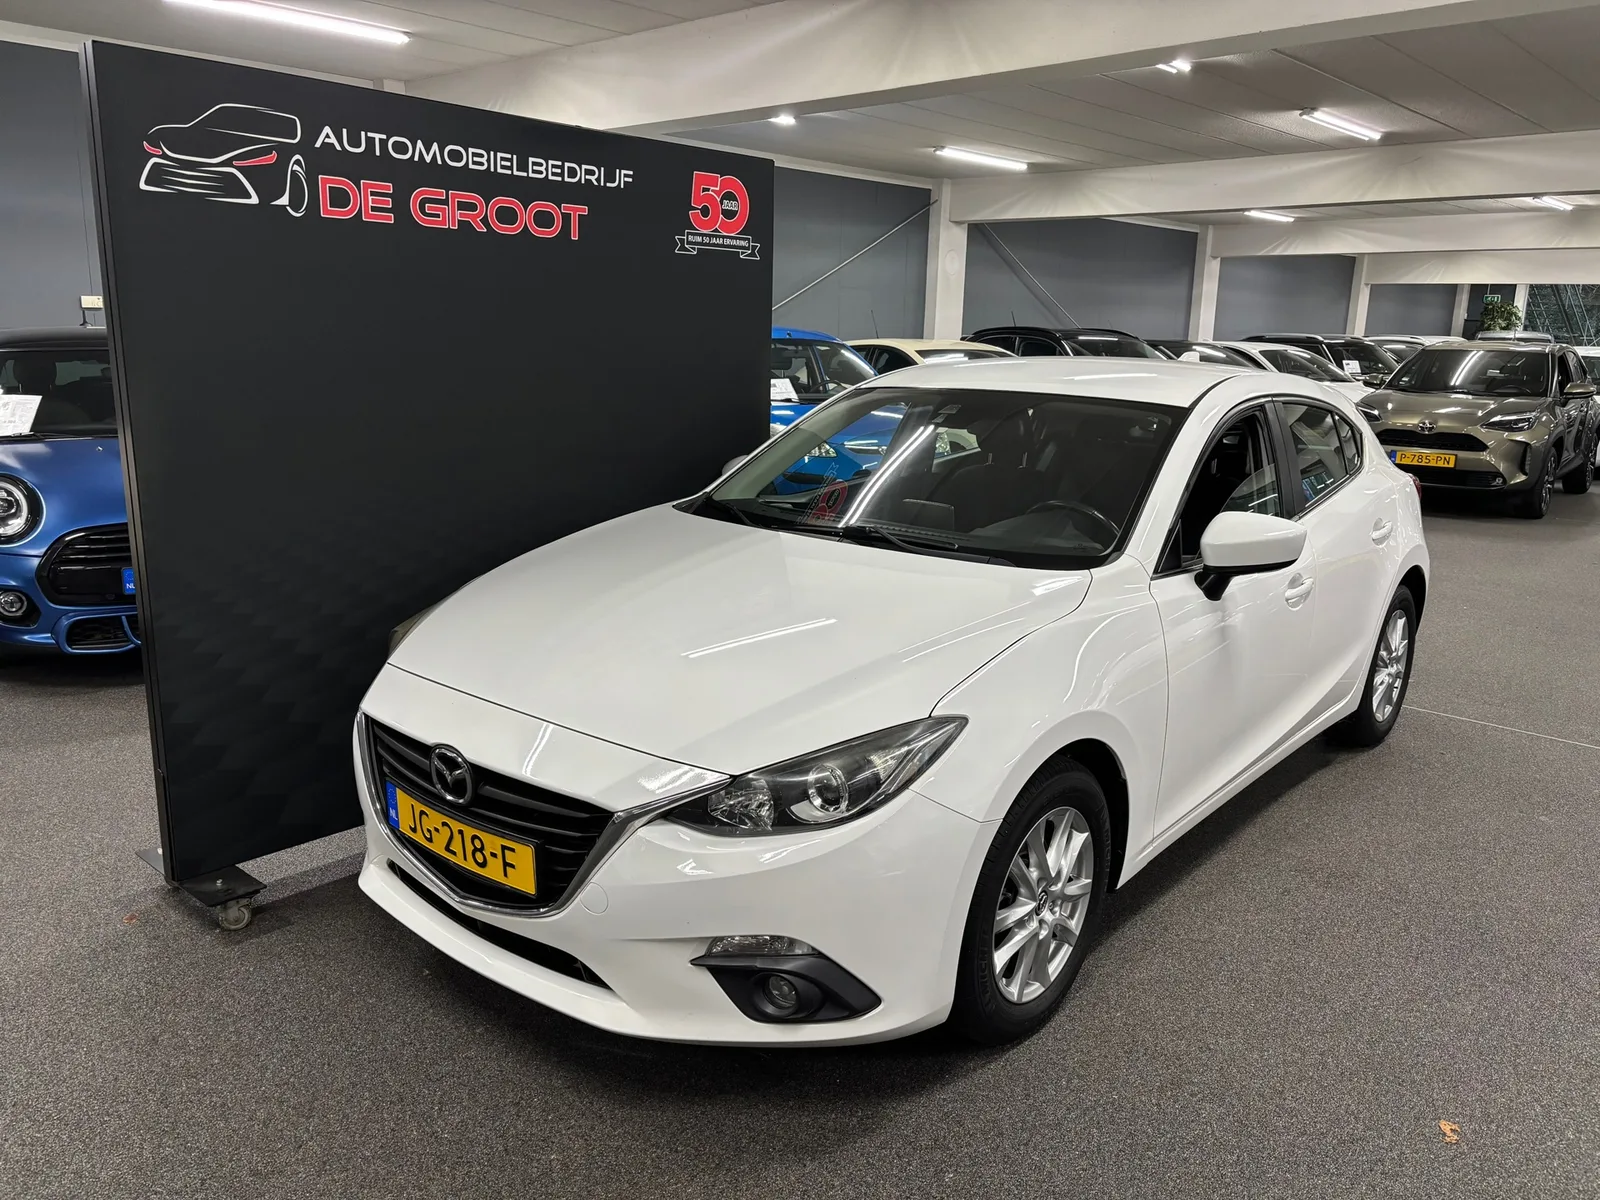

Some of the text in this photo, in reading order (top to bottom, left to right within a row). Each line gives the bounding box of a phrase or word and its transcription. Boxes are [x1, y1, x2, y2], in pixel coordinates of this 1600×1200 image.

[314, 125, 634, 189] AUTOMOBIELBEDRIJF
[318, 174, 589, 241] DE GROOT
[689, 171, 749, 235] 50
[722, 200, 738, 210] JAAR
[724, 238, 748, 247] ERVARING
[1400, 453, 1450, 465] P-785-PN
[389, 807, 398, 821] NL
[408, 803, 517, 879] JG-218-F
